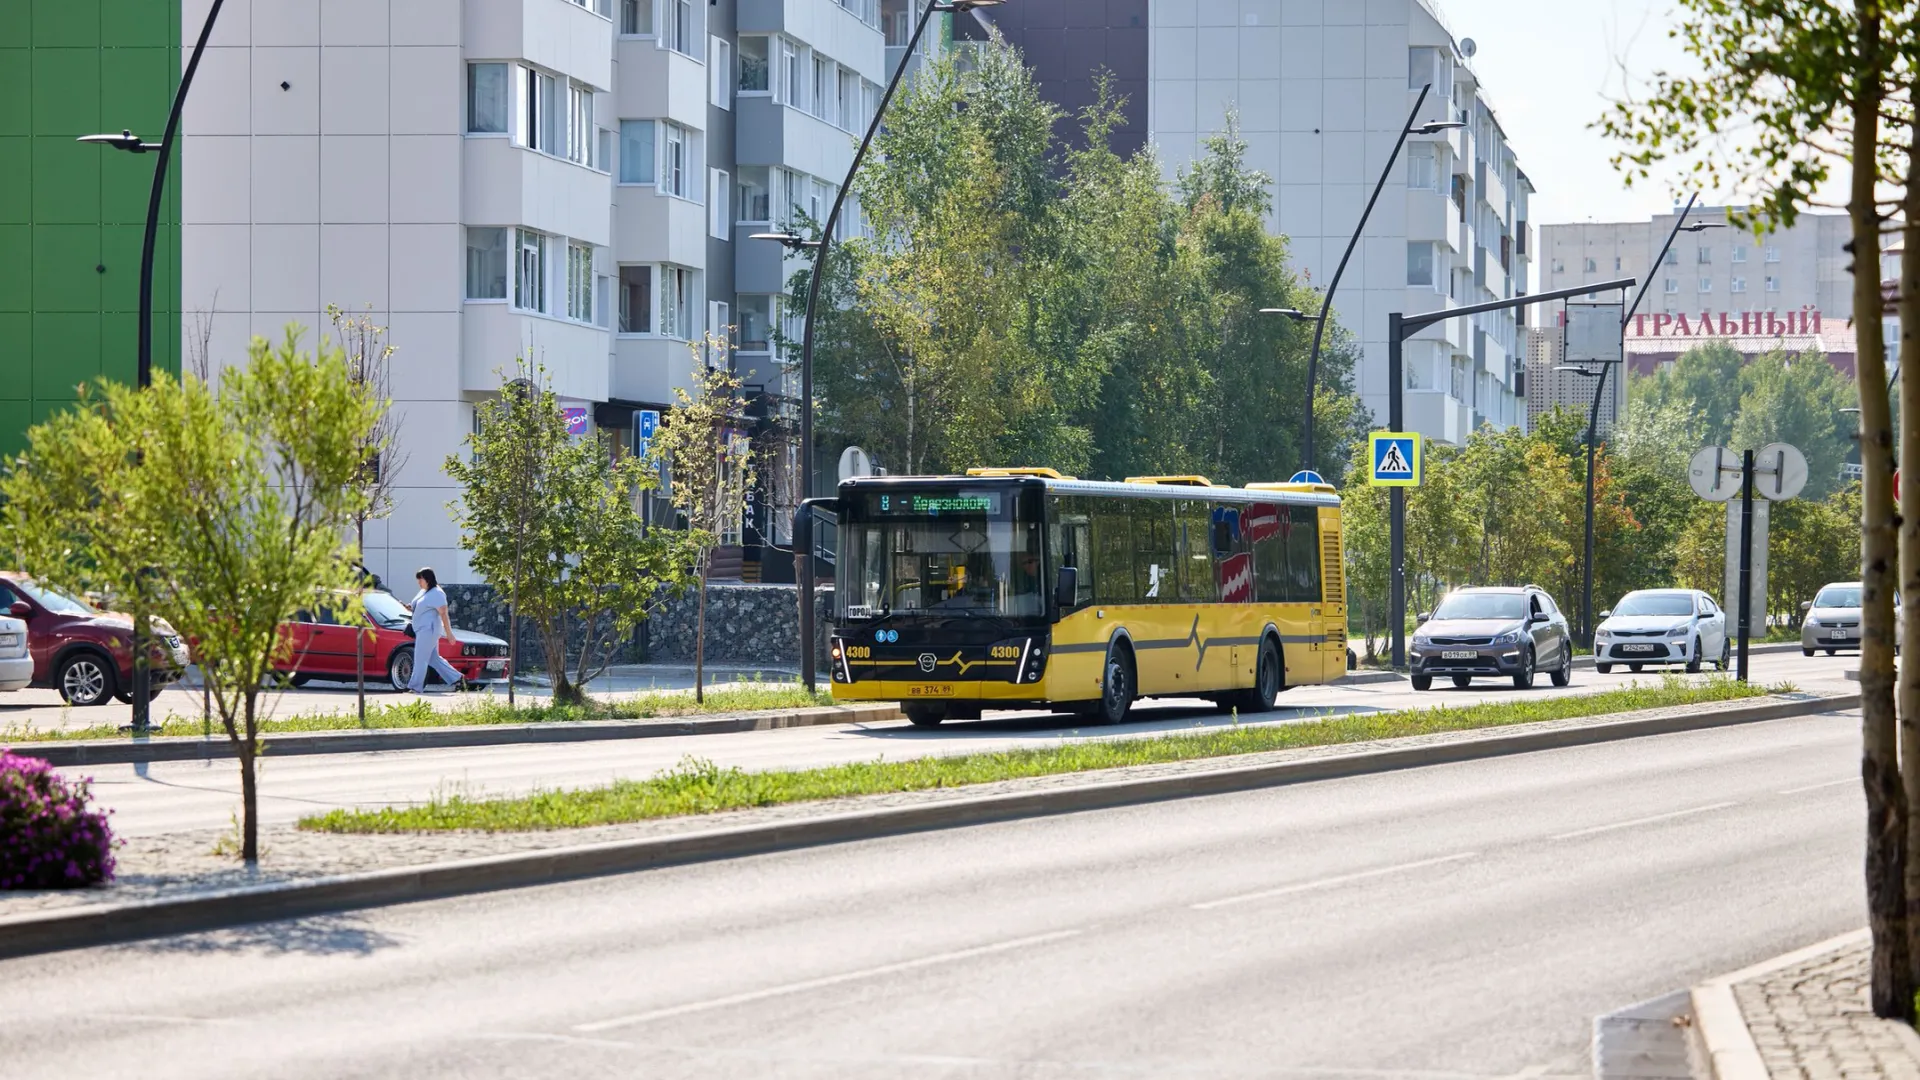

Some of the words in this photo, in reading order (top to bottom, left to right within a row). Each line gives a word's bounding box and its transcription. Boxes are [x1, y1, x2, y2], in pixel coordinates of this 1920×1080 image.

[1624, 304, 1821, 336] ТРАЛЬНЫЙ
[745, 463, 756, 529] ТБАК
[882, 495, 889, 510] 8
[849, 607, 871, 617] ГОРОД
[846, 646, 870, 658] 4300
[991, 646, 1019, 658] 4300
